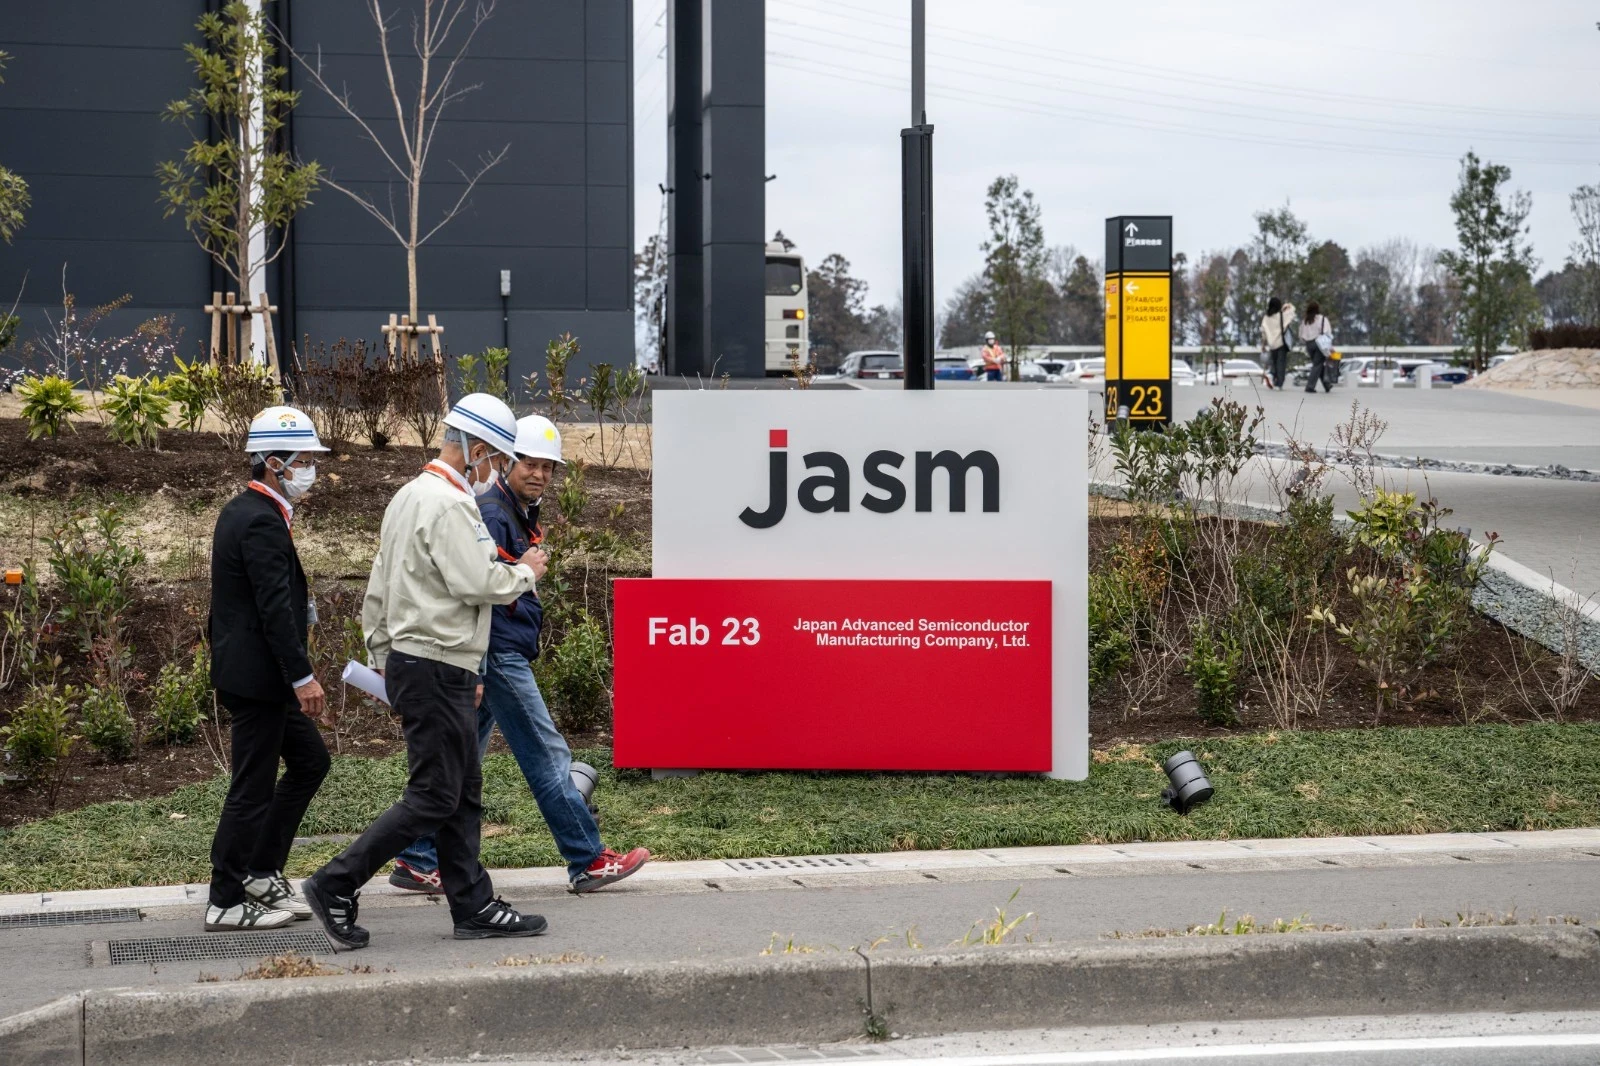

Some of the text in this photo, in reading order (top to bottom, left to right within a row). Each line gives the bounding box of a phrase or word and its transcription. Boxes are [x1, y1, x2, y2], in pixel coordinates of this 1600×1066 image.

[1107, 386, 1118, 415] 23
[1130, 385, 1162, 415] 23
[739, 429, 999, 529] jasm
[648, 617, 761, 646] Fab 23
[794, 618, 1030, 634] Japan Advanced Semiconductor
[816, 634, 1030, 650] Manufacturing Company, Ltd.
